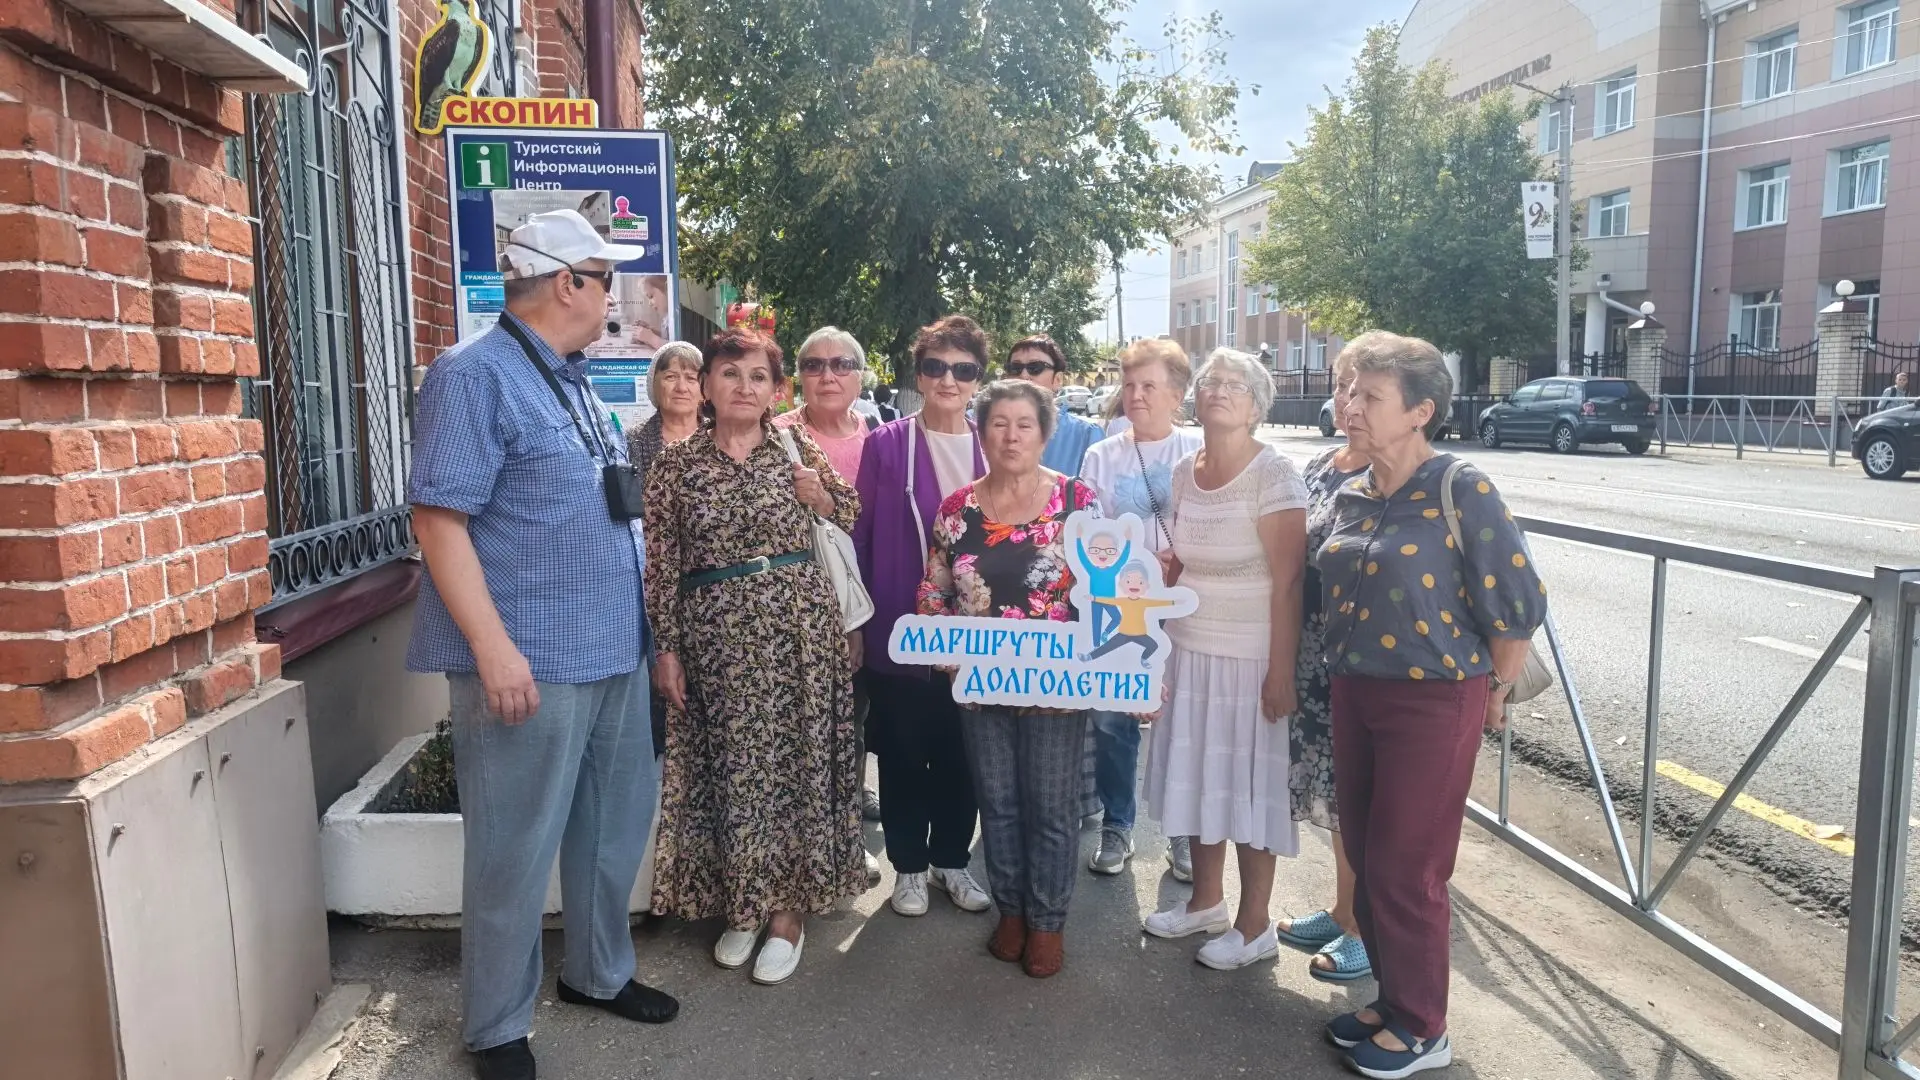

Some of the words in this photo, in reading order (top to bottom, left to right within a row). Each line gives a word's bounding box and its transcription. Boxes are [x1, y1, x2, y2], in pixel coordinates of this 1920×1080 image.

[446, 100, 592, 126] СКОПИН
[514, 141, 602, 157] Туристский
[514, 159, 657, 175] Информационный
[515, 178, 562, 191] Центр
[900, 626, 1074, 660] МАРШРУТЫ
[964, 665, 1150, 701] ДОЛГОЛЕТИЯ
